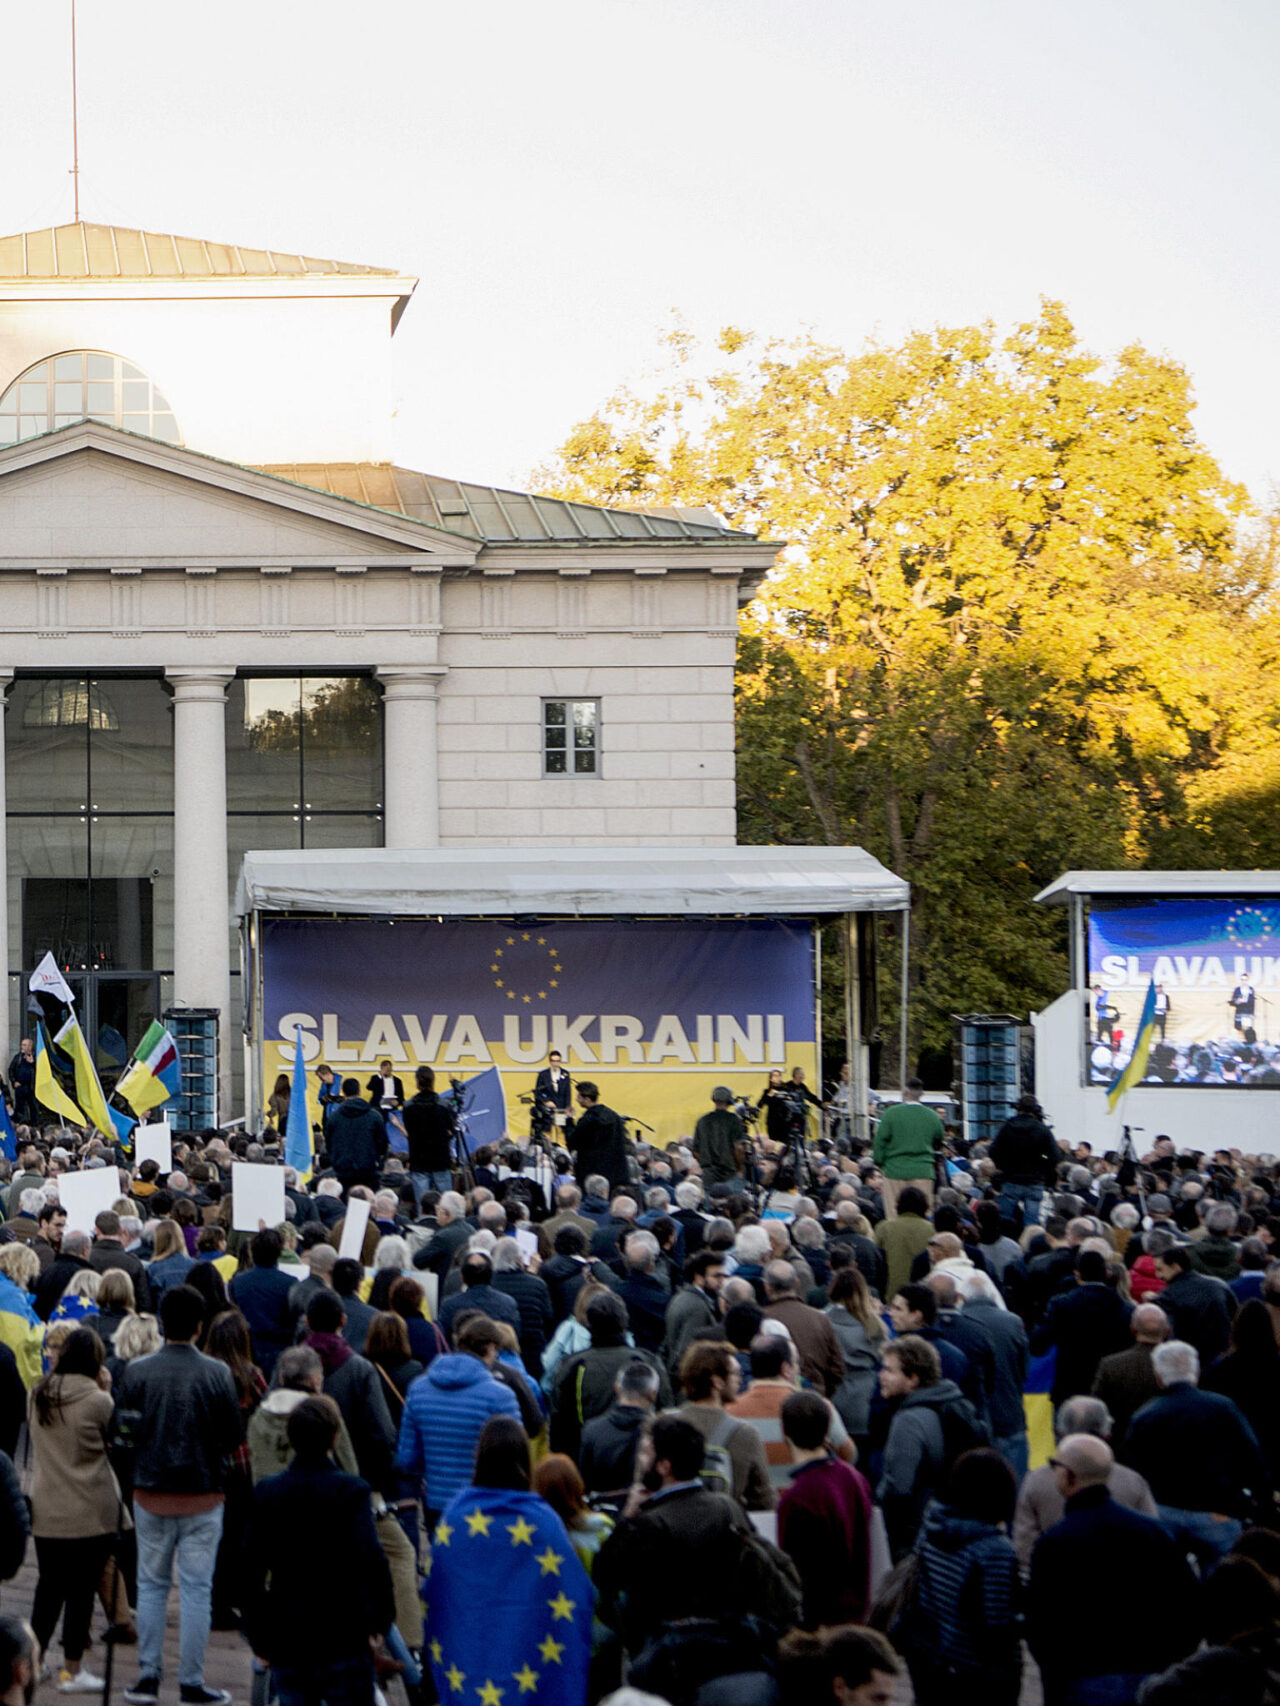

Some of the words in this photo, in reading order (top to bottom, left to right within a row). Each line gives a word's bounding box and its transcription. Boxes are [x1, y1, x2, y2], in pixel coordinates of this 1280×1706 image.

[1101, 955, 1229, 986] SLAVA
[276, 1012, 493, 1063] SLAVA
[503, 1014, 787, 1063] UKRAINI
